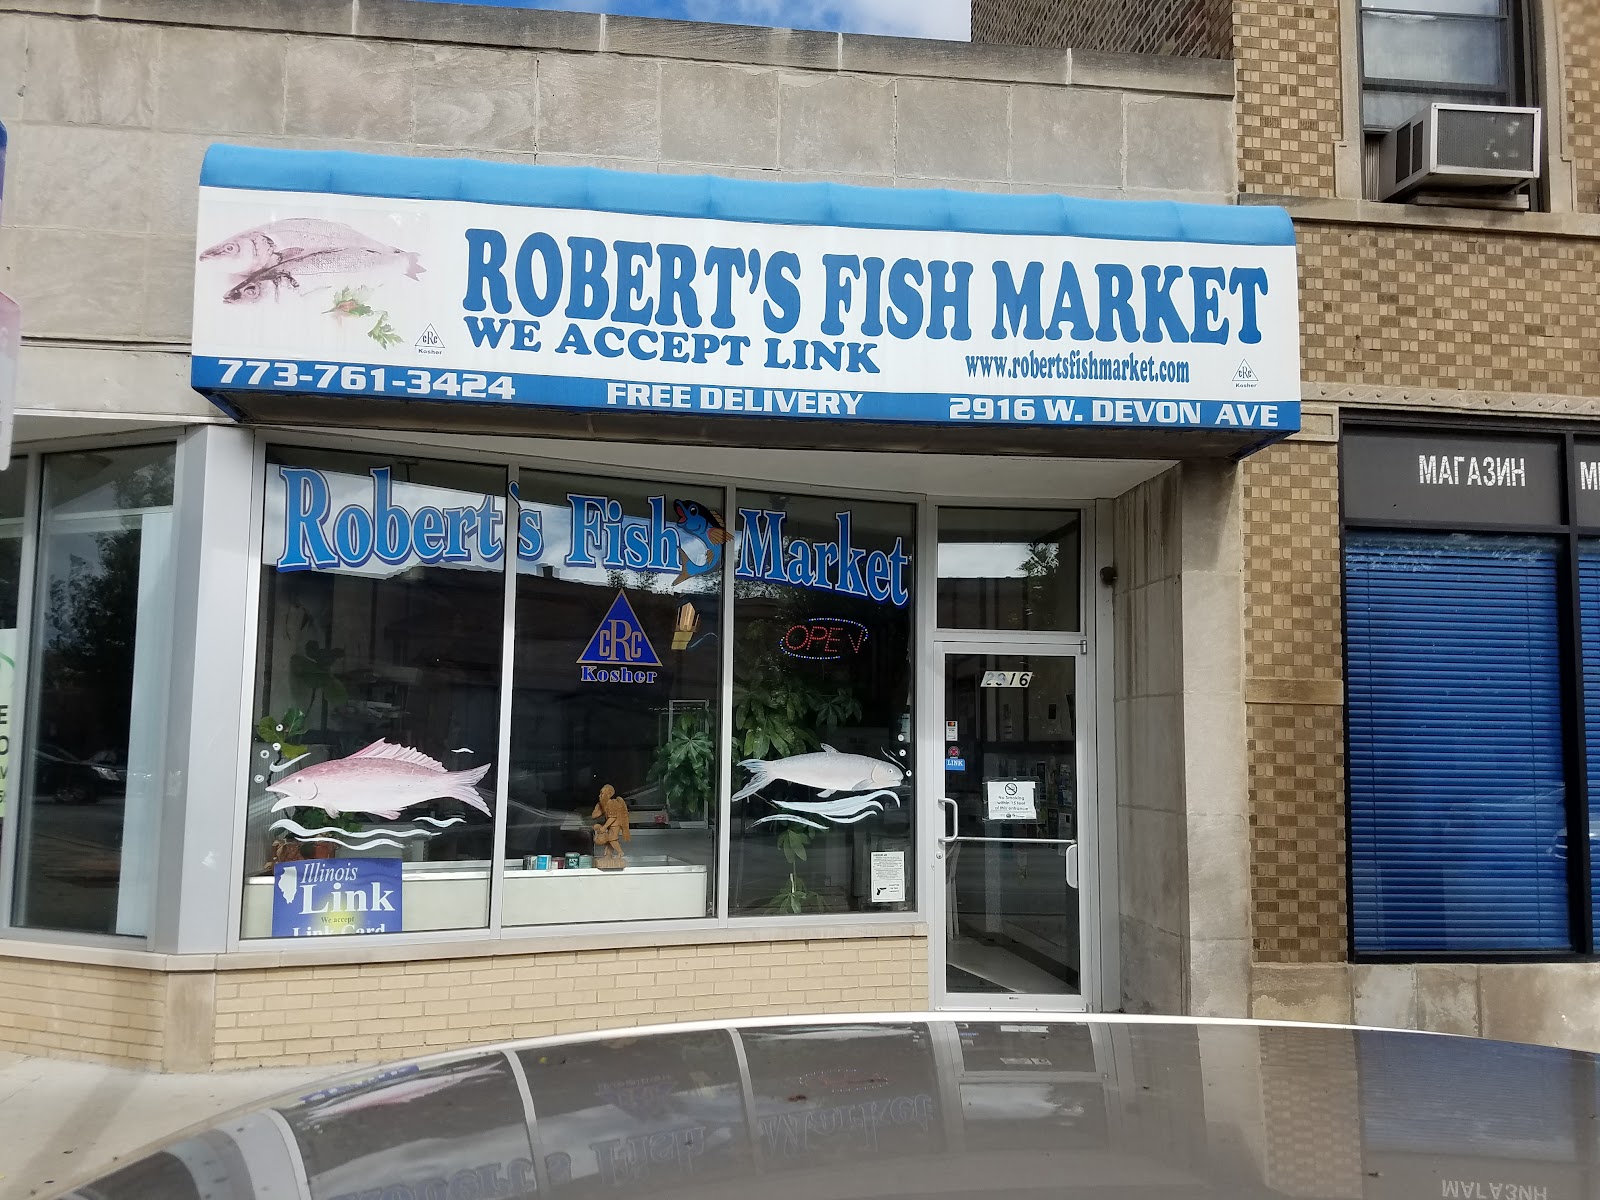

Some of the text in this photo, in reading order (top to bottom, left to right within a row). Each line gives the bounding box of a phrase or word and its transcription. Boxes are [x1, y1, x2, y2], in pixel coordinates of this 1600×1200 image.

[462, 228, 1269, 346] ROBERT'S FISH MARKET
[463, 315, 881, 374] WE ACCEPT LINK
[217, 358, 516, 401] 773-761-3424
[965, 349, 1190, 384] www.robertsfishmarket.com
[606, 381, 863, 417] FREE DELIVERY
[948, 397, 1279, 428] 2916 W. DEVON AVE
[1418, 454, 1526, 487] МАГАЗИН
[276, 465, 911, 607] Robert's Fish Market
[580, 665, 658, 684] Kosher
[947, 759, 964, 767] LINK
[300, 862, 358, 884] Illinois
[298, 882, 396, 915] Link
[333, 916, 355, 924] accept
